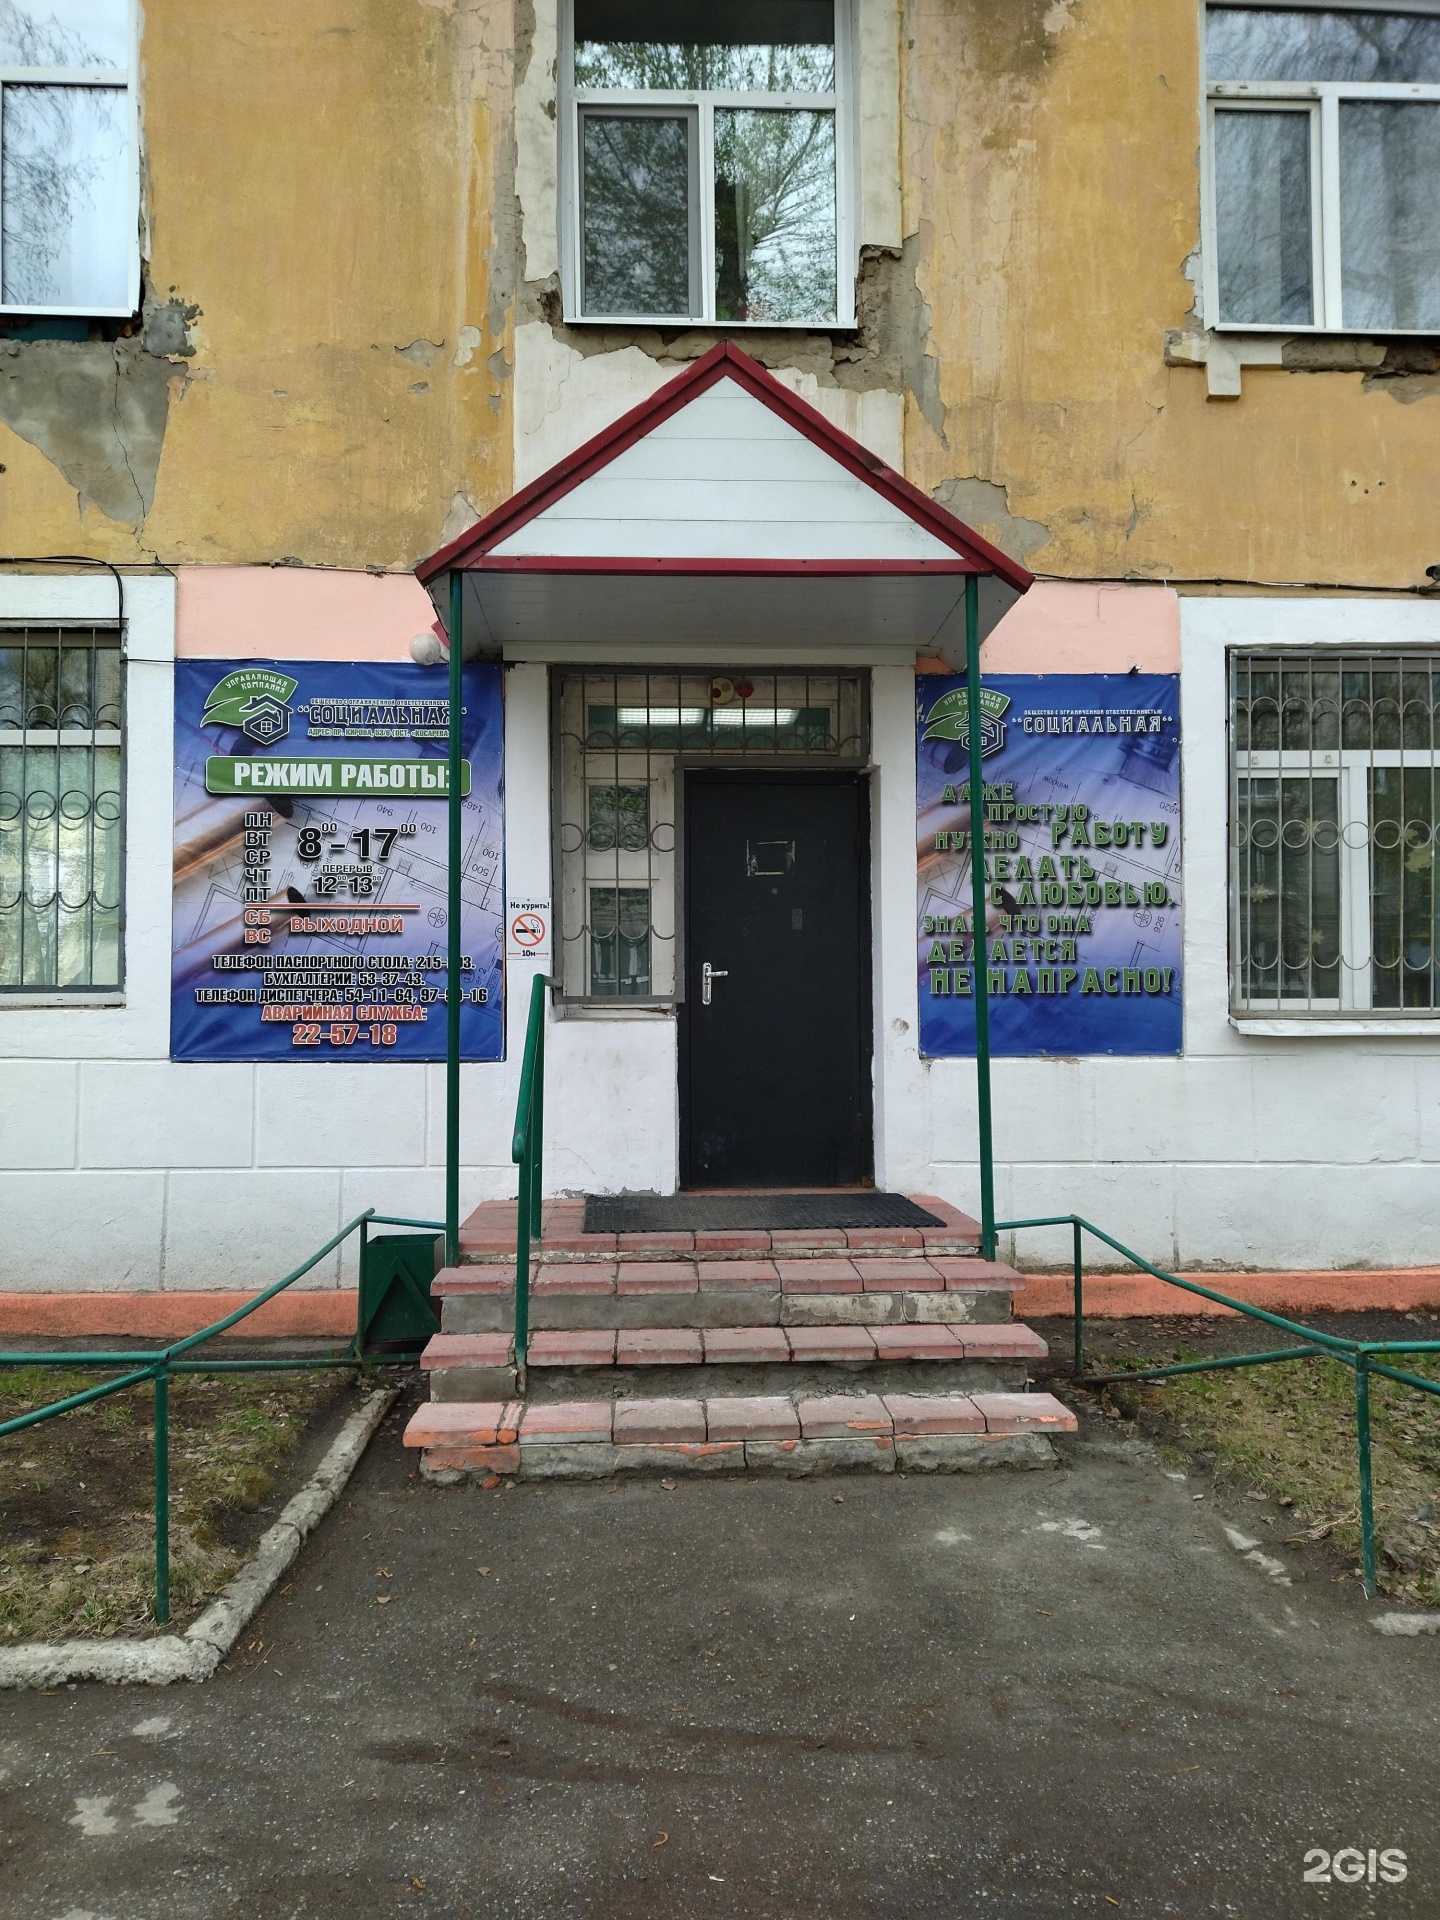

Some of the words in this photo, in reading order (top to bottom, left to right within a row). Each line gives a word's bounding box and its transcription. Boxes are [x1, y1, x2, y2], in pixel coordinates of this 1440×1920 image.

[225, 673, 288, 688] УПРАВЛЯЮЩАЯ
[241, 681, 286, 694] КОМПАНИЯ
[234, 762, 333, 787] РЕЖИМ
[244, 812, 272, 828] ПН
[987, 803, 1088, 821] ПРОСТУЮ
[245, 831, 271, 846] ВТ
[1050, 821, 1168, 845] РАБОТУ
[244, 849, 271, 865] СР
[245, 868, 271, 883] ЧТ
[322, 864, 373, 874] ПЕРЕРЫВ
[245, 887, 272, 901] ПТ
[989, 881, 1003, 905] С
[510, 901, 520, 909] Не
[521, 901, 550, 910] курить!
[244, 909, 271, 924] СБ
[290, 914, 404, 935] ВЫХОДНОЙ
[1000, 915, 1040, 932] ЧТО
[1047, 915, 1091, 932] ОНА
[244, 929, 271, 944] ВС
[212, 955, 273, 969] ТЕЛЕФОН
[275, 955, 364, 969] ПАСПОРТНОГО
[367, 956, 413, 969] СТОЛА:
[264, 972, 357, 985] БУХГАЛТЕРИИ:
[359, 972, 426, 985] 53-37-43.
[929, 967, 972, 994] НЕ
[986, 967, 1173, 994] НАПРАСНО!
[195, 988, 257, 1002] ТЕЛЕФОН
[259, 988, 343, 1004] ДИСПЕТЧЕРА:
[346, 988, 417, 1003] 54-11-64,
[261, 1003, 353, 1021] АВАРИЙНАЯ
[356, 1004, 428, 1020] СЛУЖБА:
[292, 1023, 397, 1045] 22-57-18
